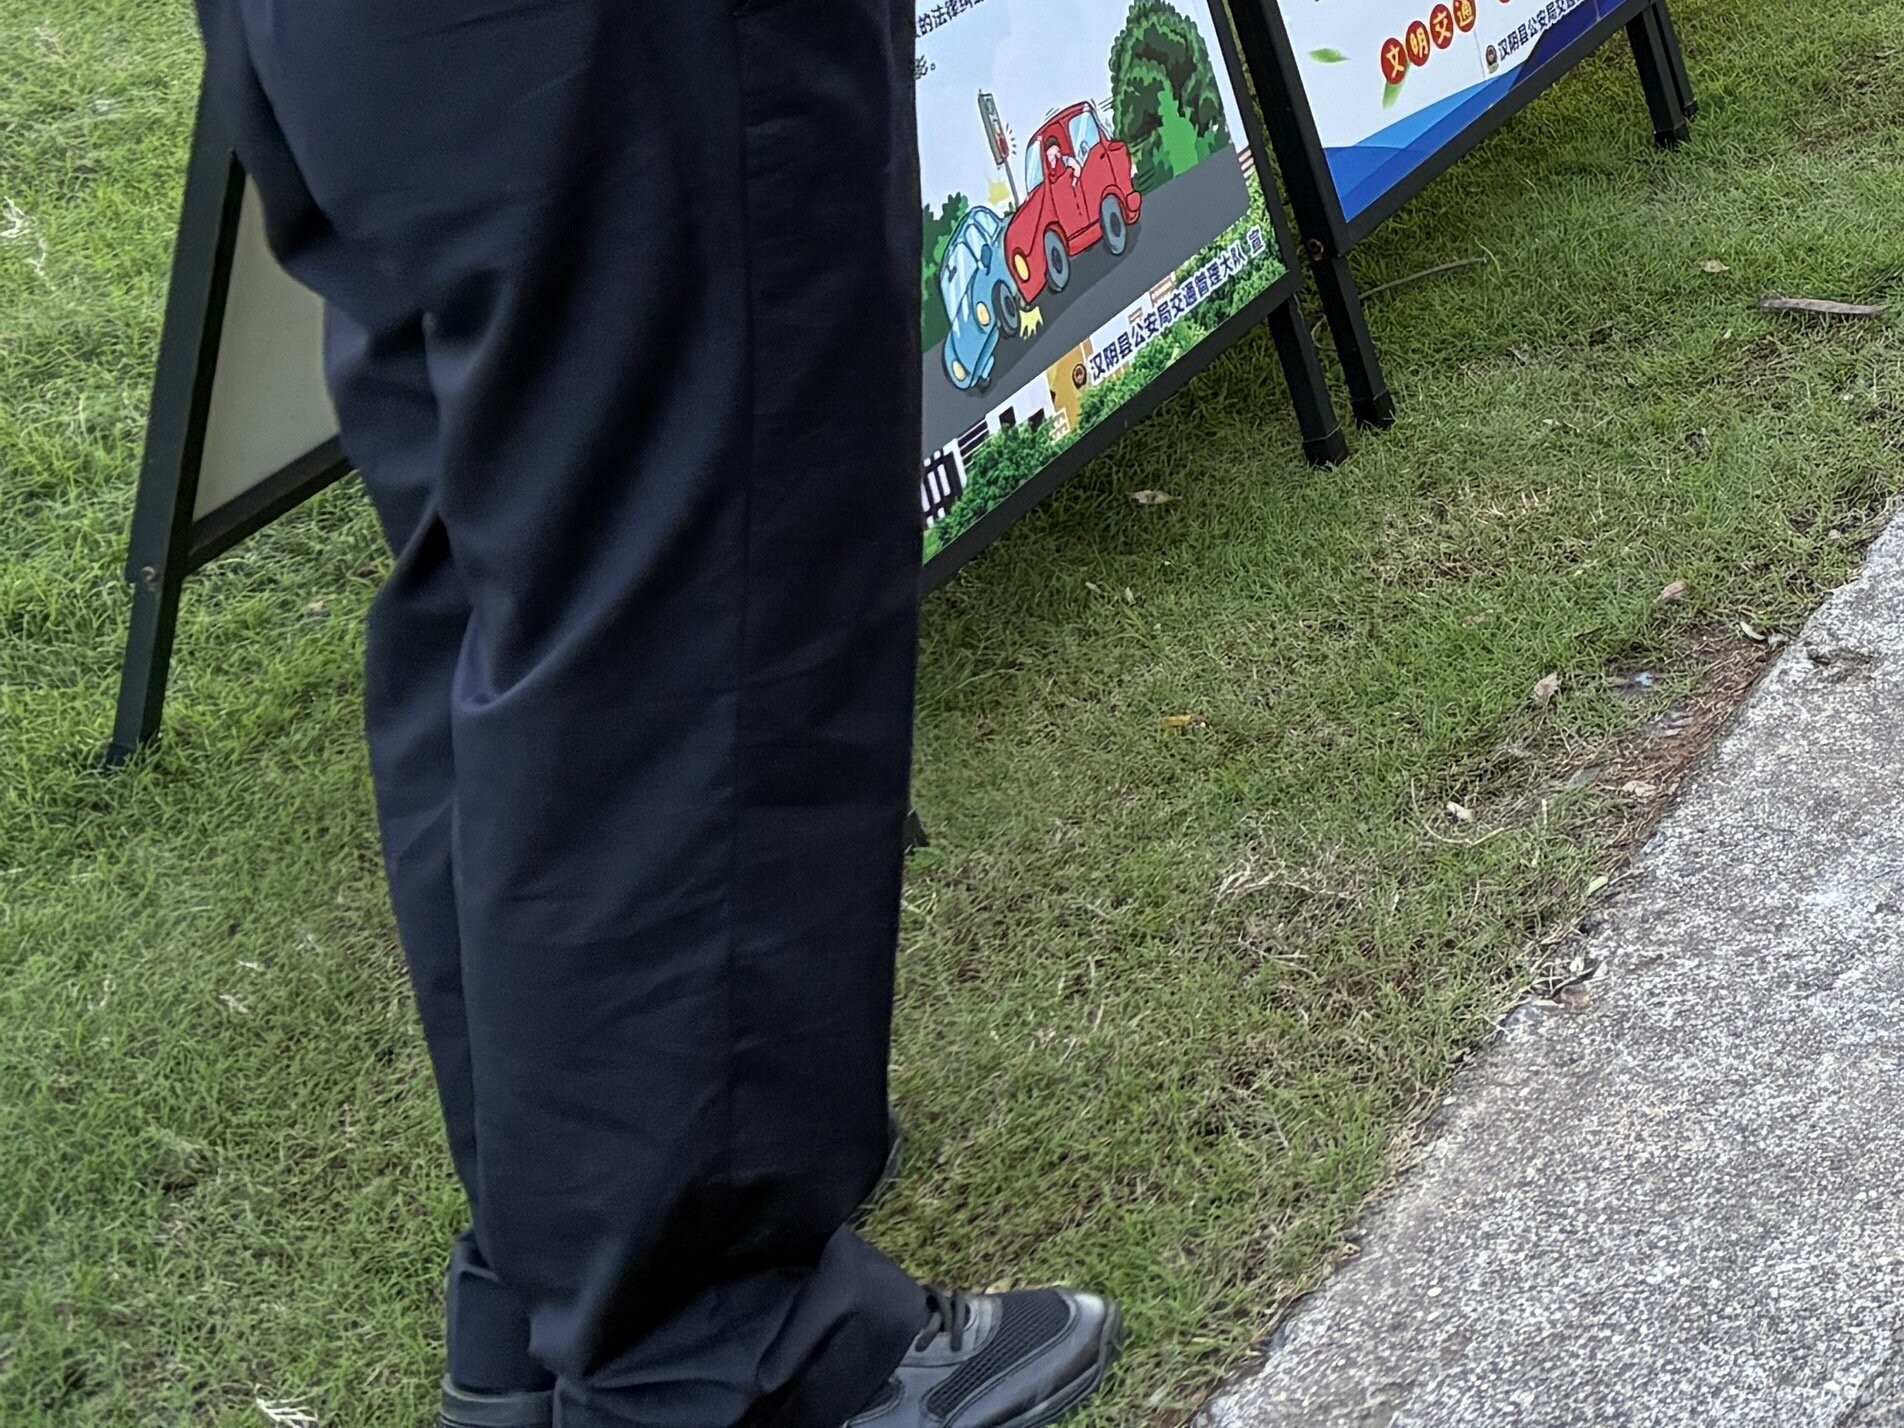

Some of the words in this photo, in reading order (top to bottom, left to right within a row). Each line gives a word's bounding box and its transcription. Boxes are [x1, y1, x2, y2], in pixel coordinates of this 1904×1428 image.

[1087, 239, 1246, 382] 汉阴县公安局交通管理大队
[1247, 226, 1264, 255] 宣
